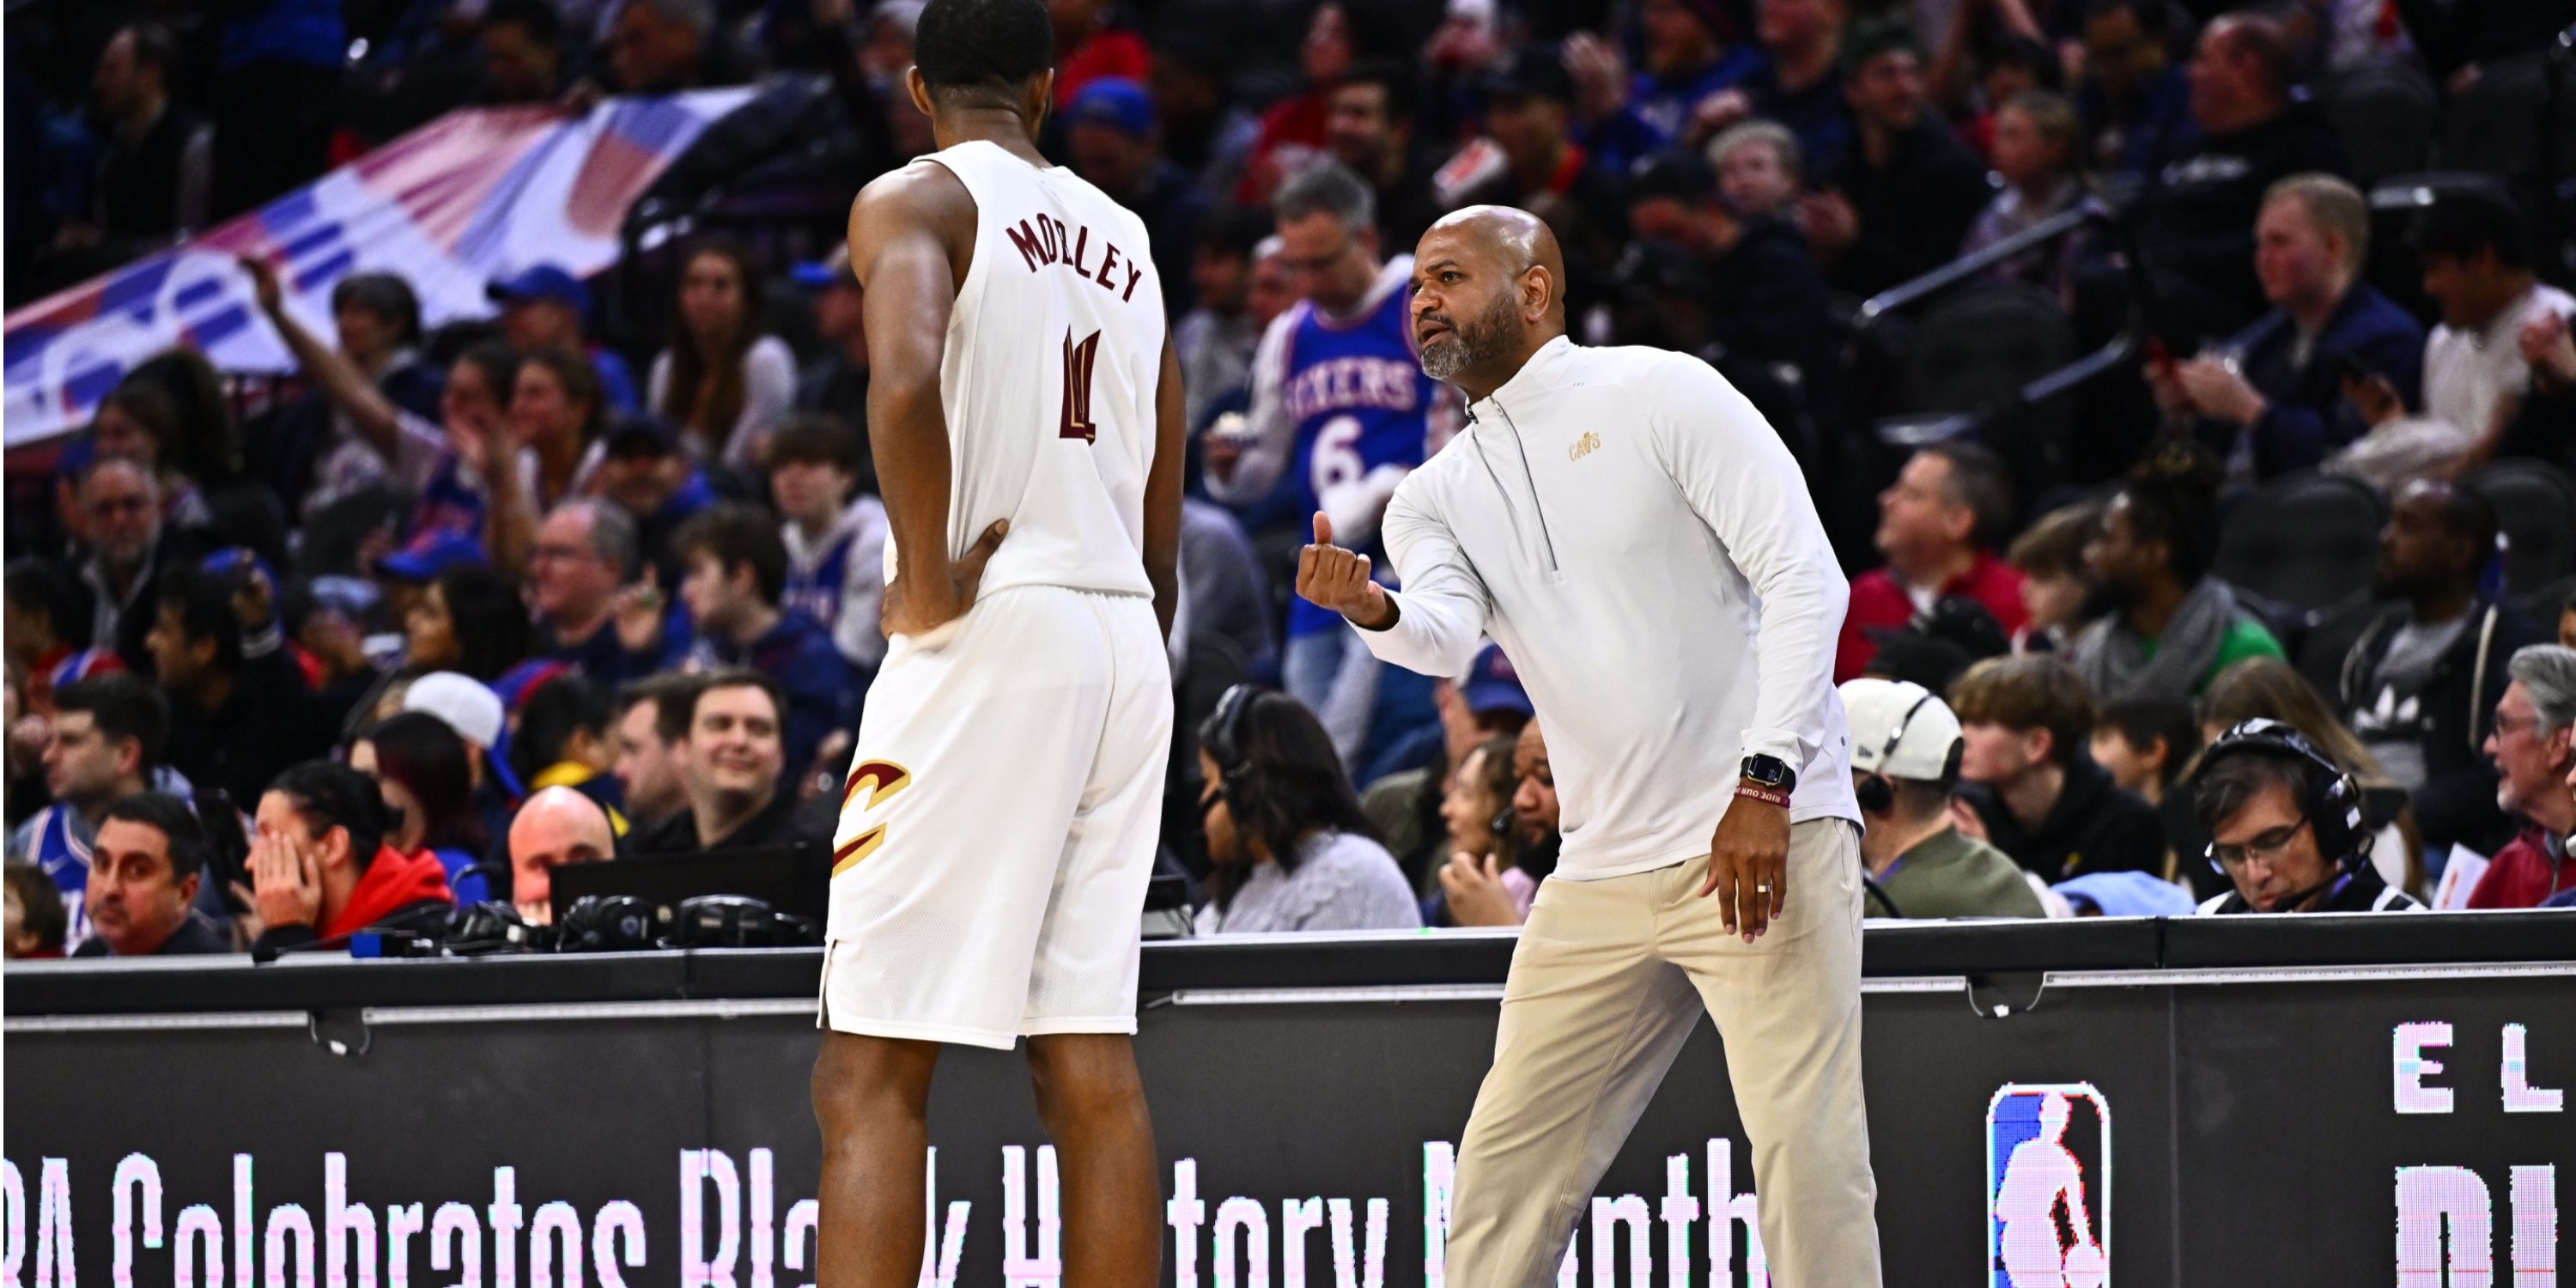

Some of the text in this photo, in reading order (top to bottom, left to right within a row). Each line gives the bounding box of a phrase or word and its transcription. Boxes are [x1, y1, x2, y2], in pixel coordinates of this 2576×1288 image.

[1005, 213, 1142, 303] MOBLEY
[1310, 416, 1364, 486] 6
[1568, 431, 1601, 462] CAVS
[1741, 787, 1759, 797] OUR
[1760, 791, 1781, 803] RIDE
[680, 1147, 972, 1288] Blk
[1002, 1145, 1389, 1288] Htory
